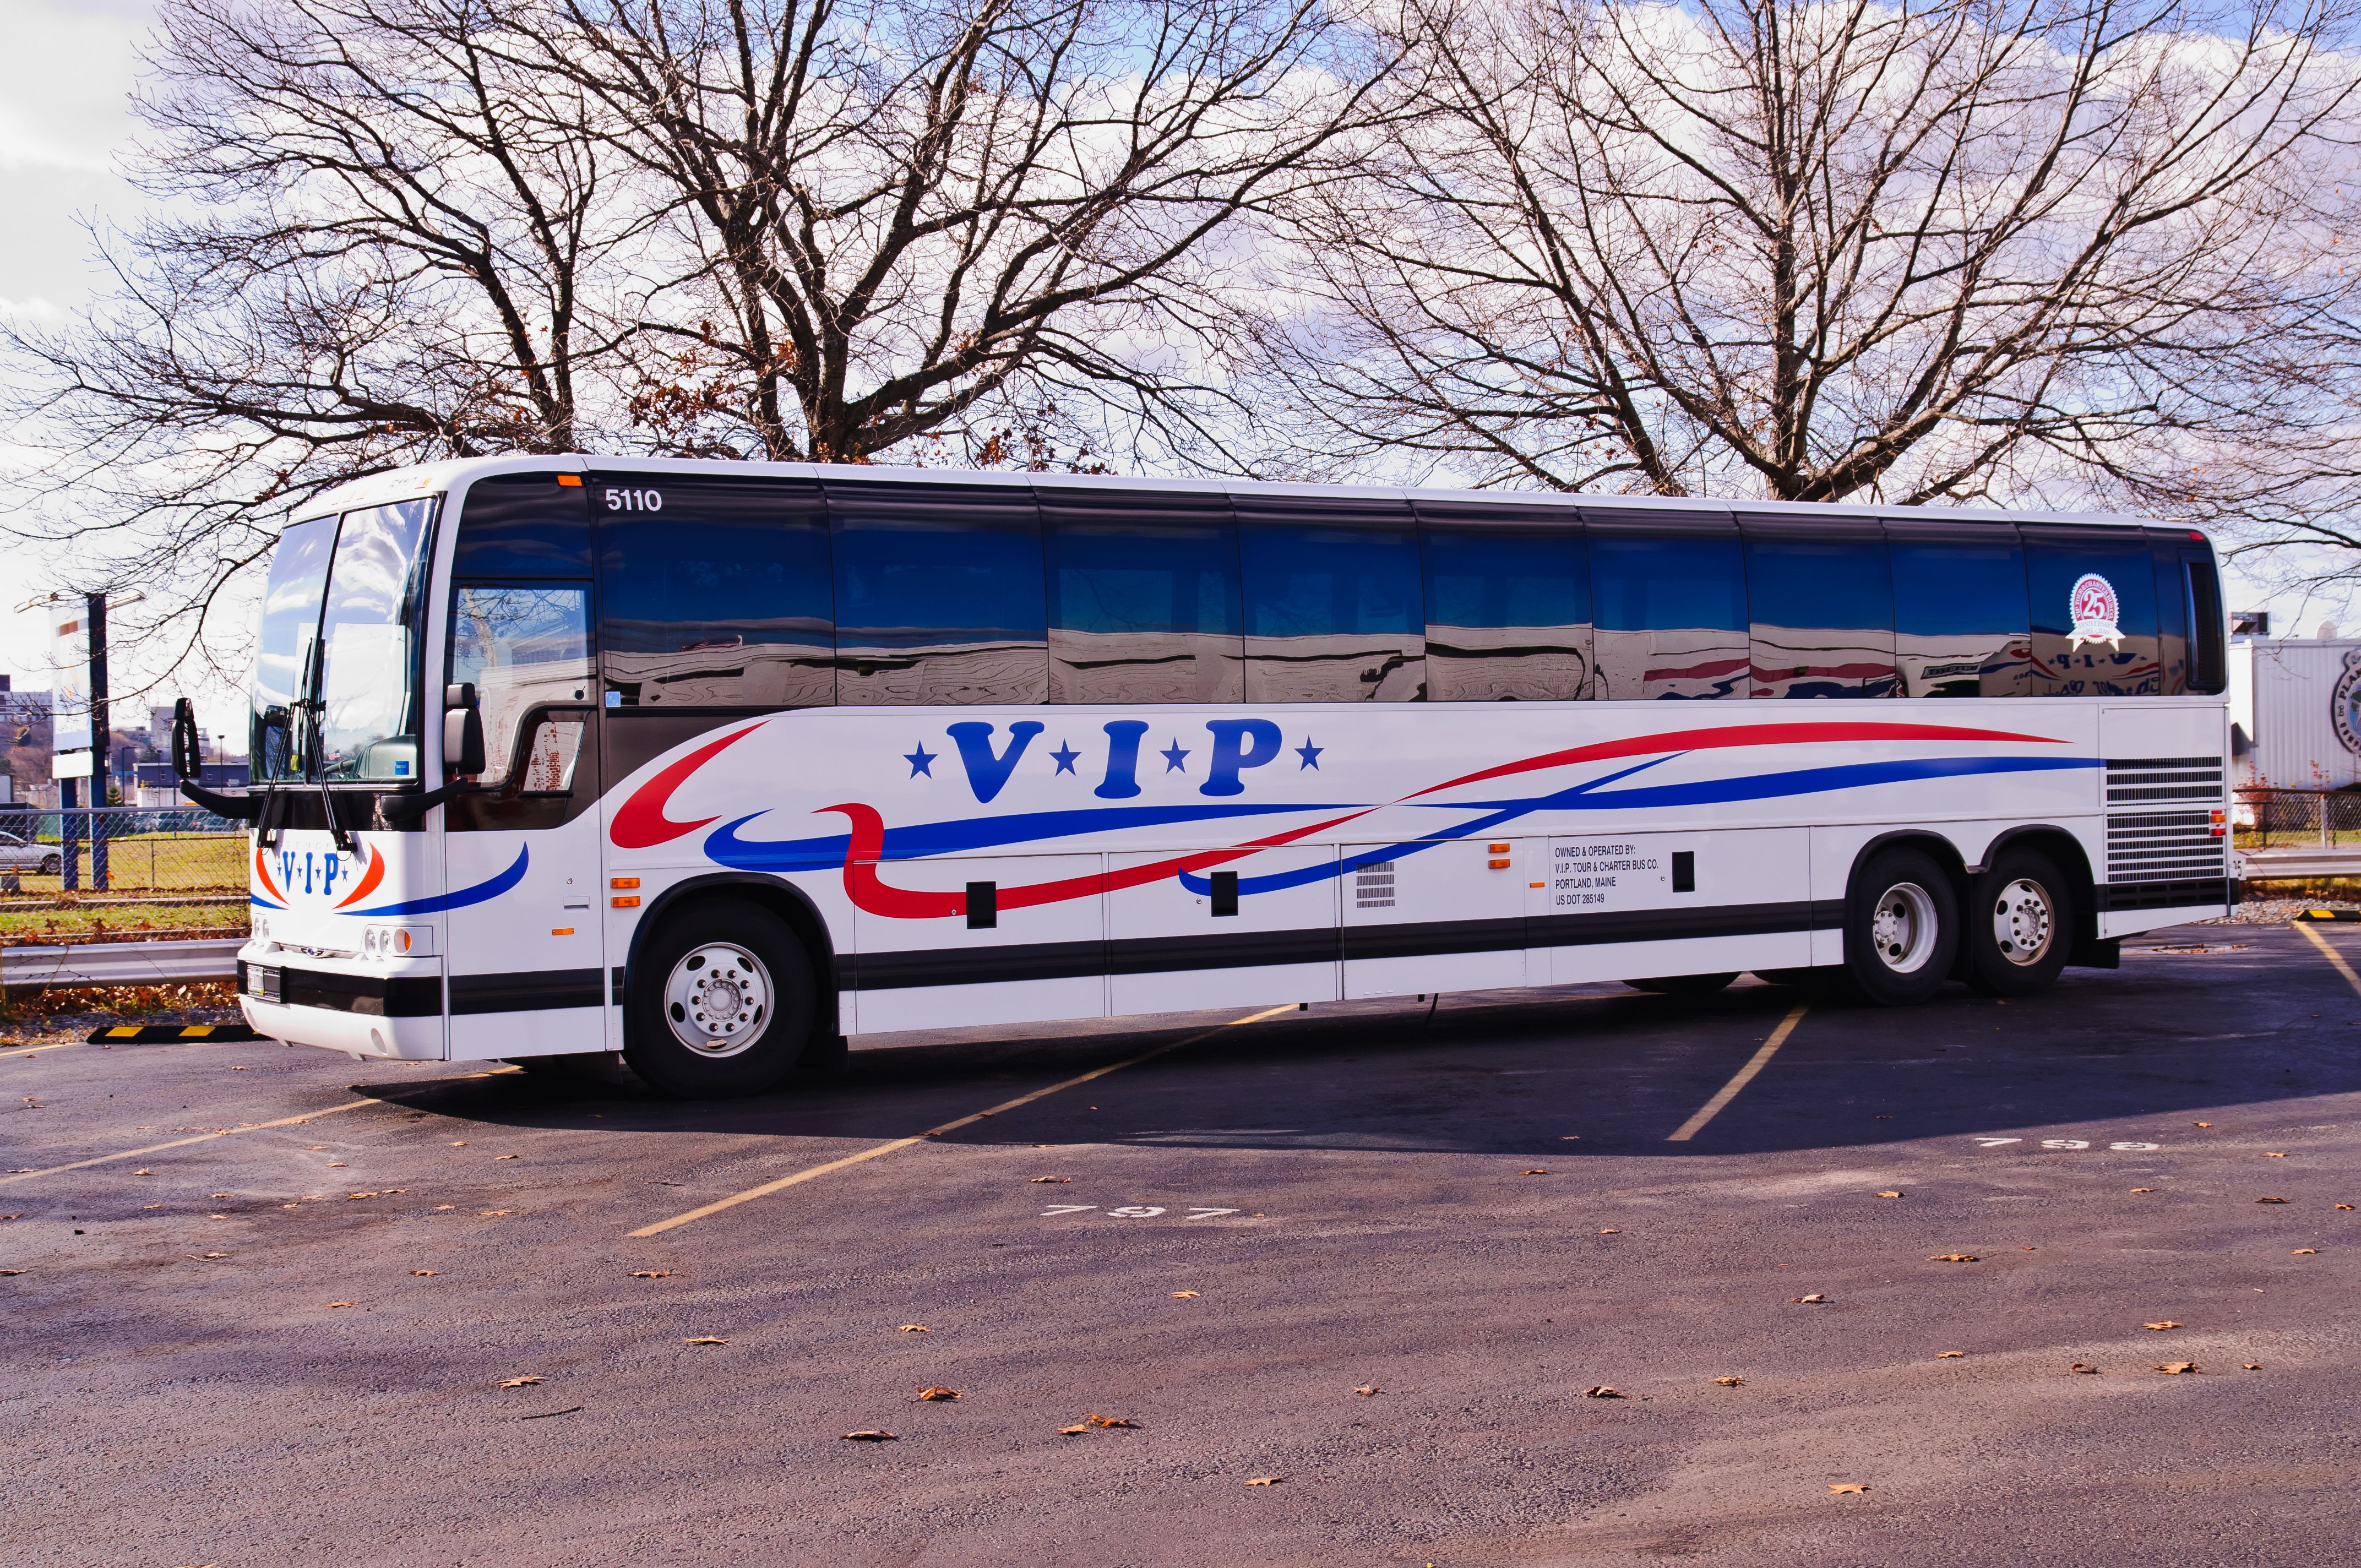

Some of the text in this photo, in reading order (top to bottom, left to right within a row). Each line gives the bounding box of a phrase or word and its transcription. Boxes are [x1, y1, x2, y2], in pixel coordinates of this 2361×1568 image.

[606, 489, 662, 511] 5110
[2078, 620, 2113, 629] ANNIVERSARY
[1555, 845, 1636, 858] OWNED & OPERATED BY:
[1555, 859, 1659, 873] V.I.P. TOUR & CHARTER BUS CO.
[1555, 876, 1616, 890] PORTLAND, MAINE
[1556, 894, 1604, 905] US DOT 285149
[1040, 1205, 1241, 1219] 797
